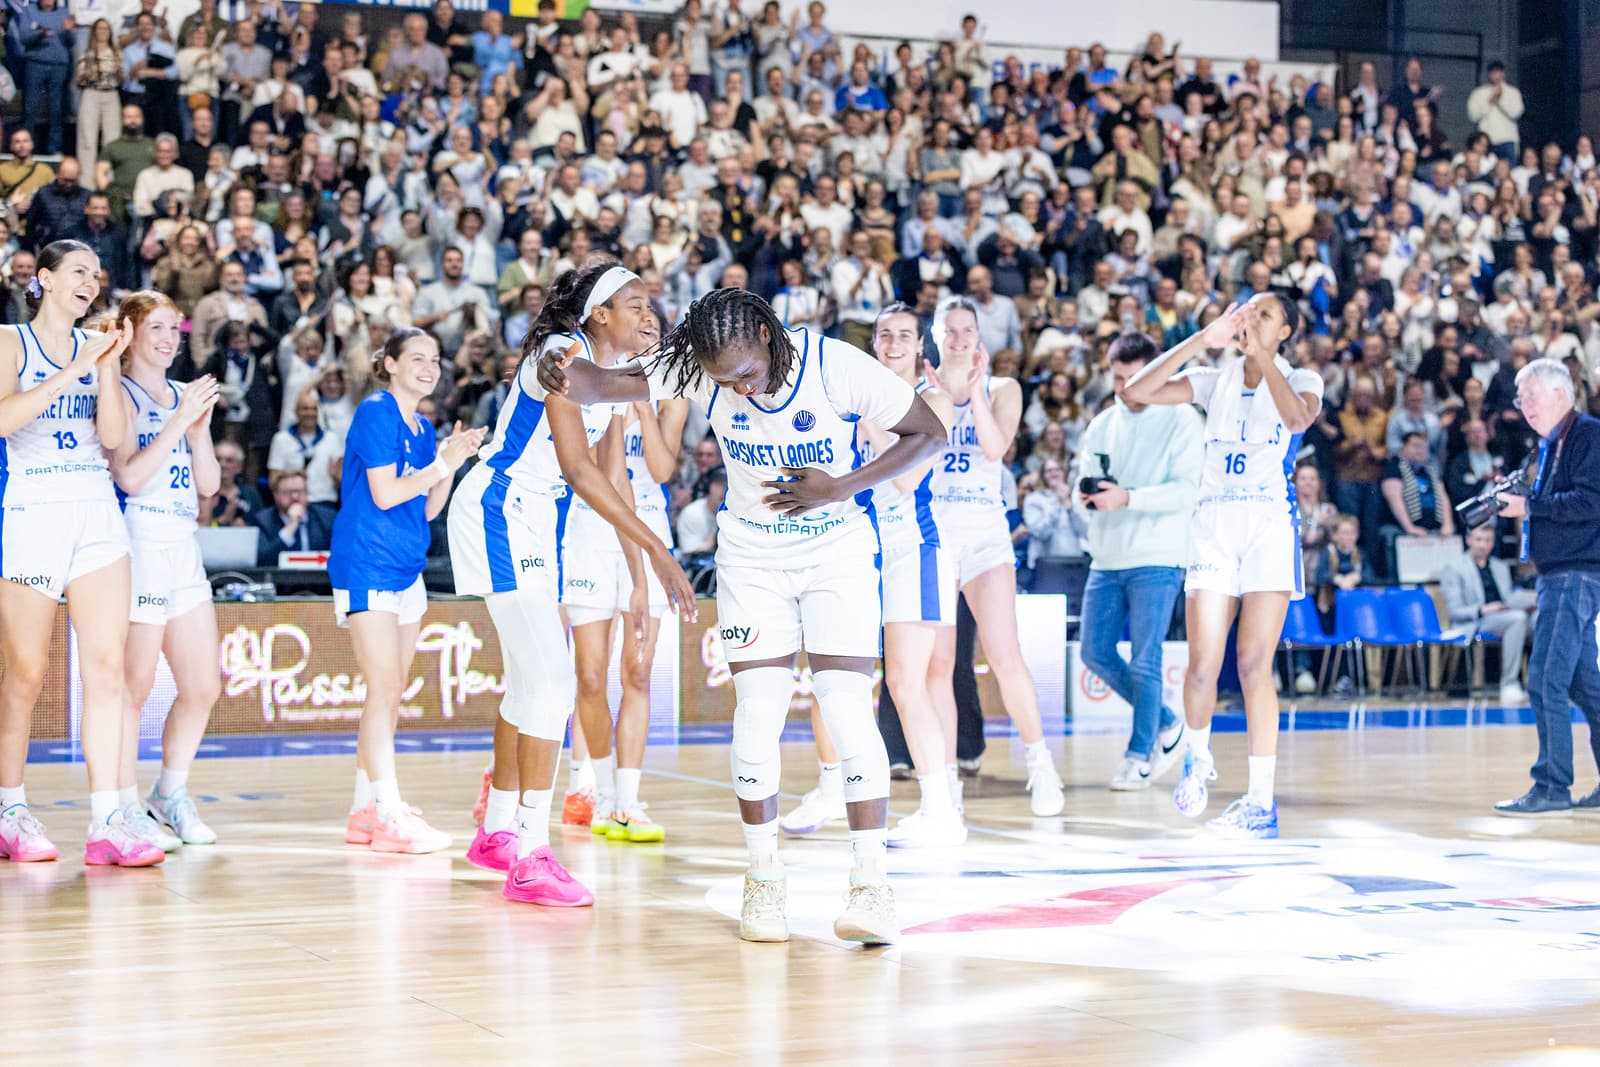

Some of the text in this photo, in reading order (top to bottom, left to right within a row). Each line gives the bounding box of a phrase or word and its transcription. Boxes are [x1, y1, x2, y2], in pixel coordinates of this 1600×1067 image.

[52, 431, 78, 450] 13
[722, 435, 777, 467] BASKET
[777, 437, 834, 468] LANDES
[943, 452, 970, 473] 25
[1224, 452, 1247, 475] 16
[169, 465, 190, 489] 28
[10, 573, 52, 589] picoty
